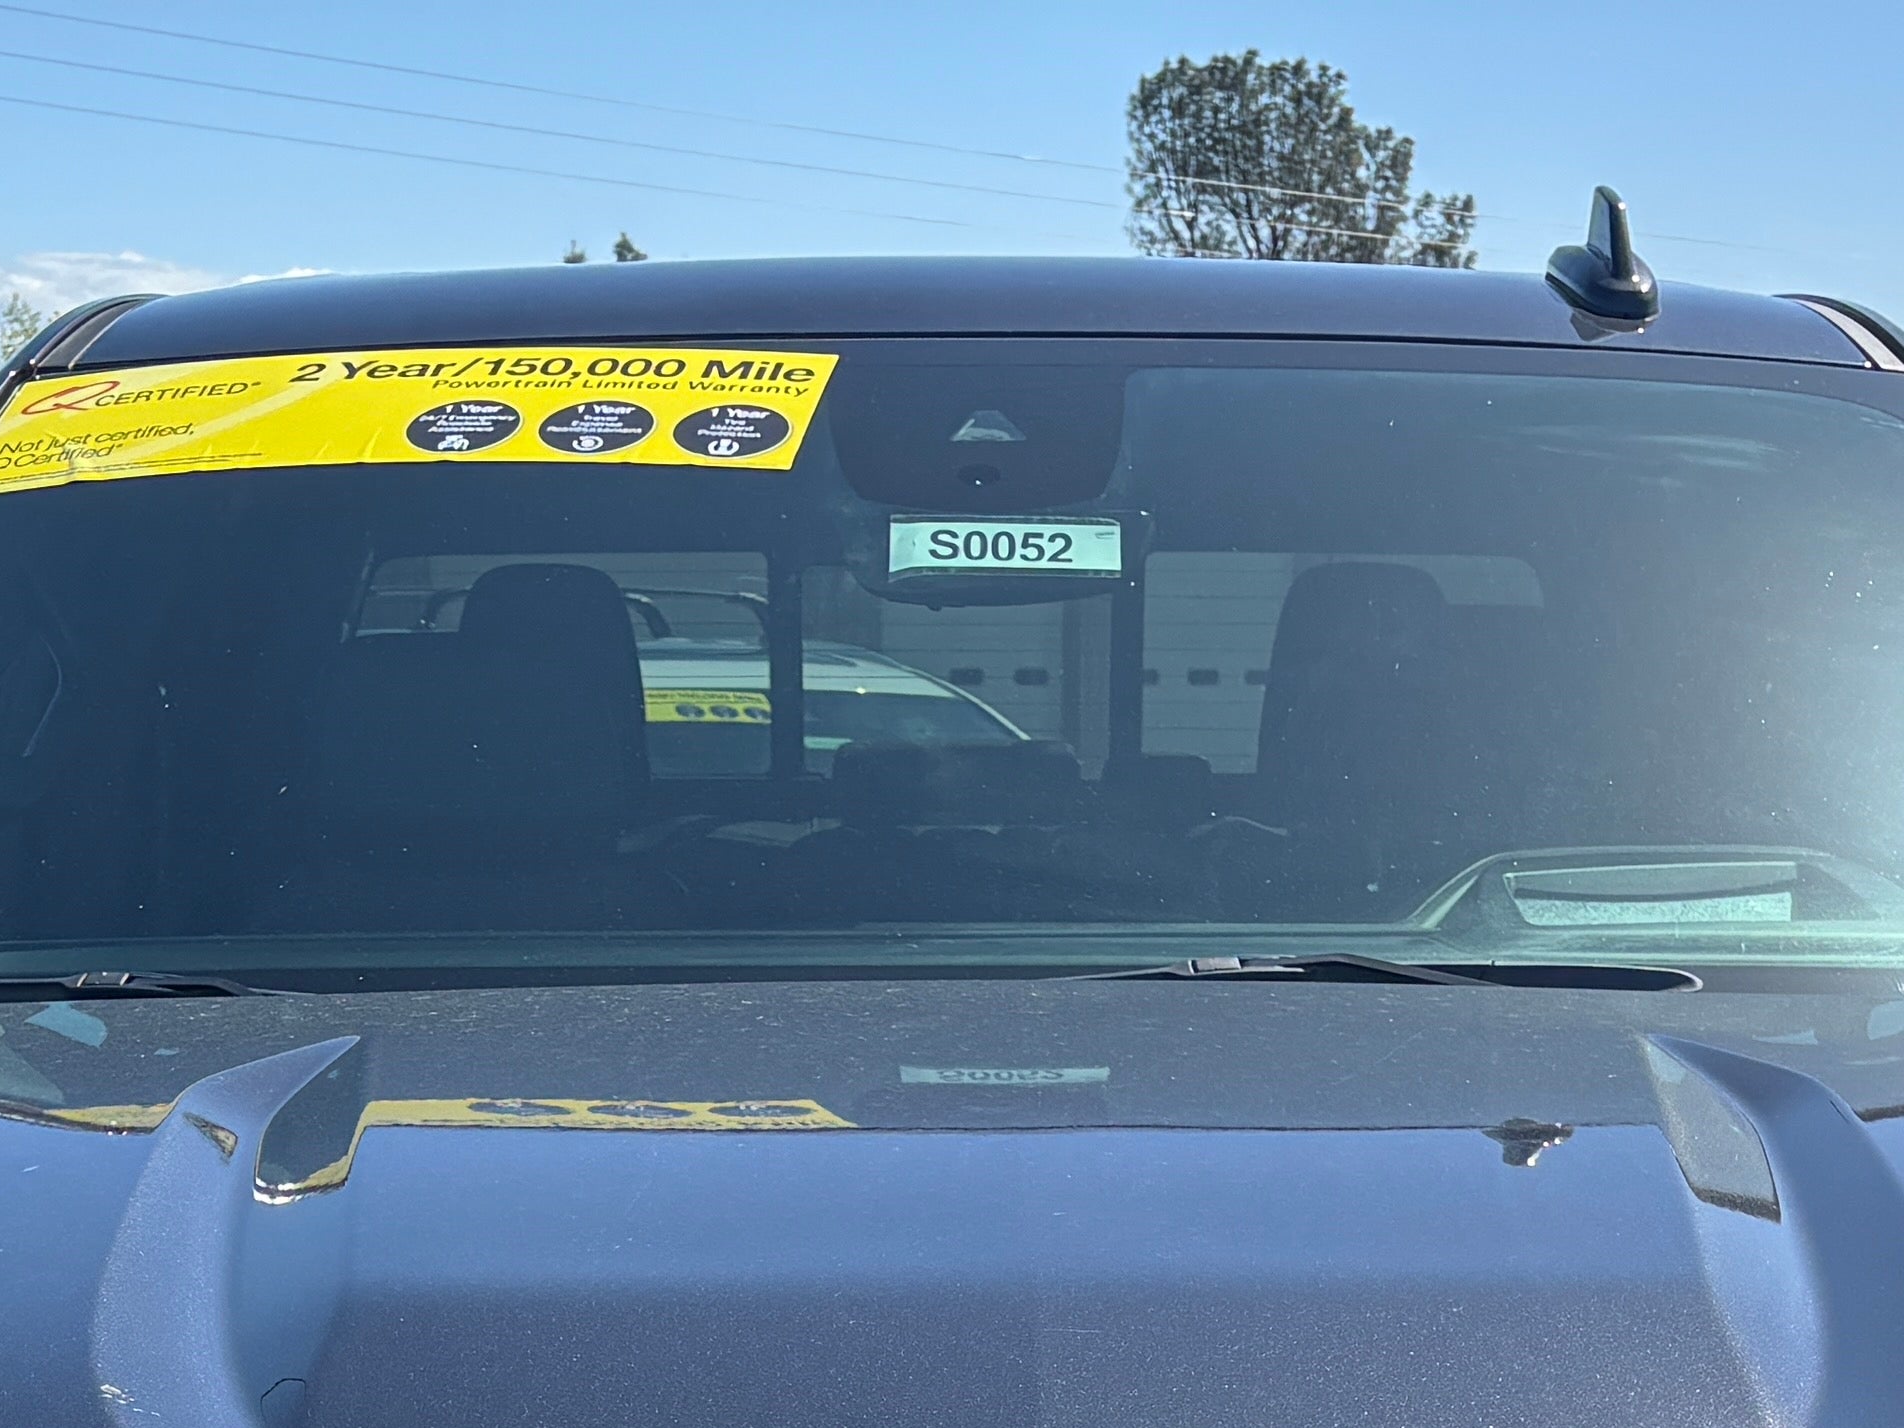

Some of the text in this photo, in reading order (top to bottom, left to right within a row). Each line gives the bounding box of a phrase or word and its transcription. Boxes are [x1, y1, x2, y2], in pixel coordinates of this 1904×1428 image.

[289, 357, 815, 383] 2 Year/150,000 Mile
[432, 379, 809, 397] Powertrain Limited Warranty
[461, 404, 503, 414] Year
[593, 404, 636, 414] Year
[727, 408, 771, 419] Year
[0, 440, 43, 455] Not
[46, 433, 92, 451] just
[928, 529, 1073, 563] S0052
